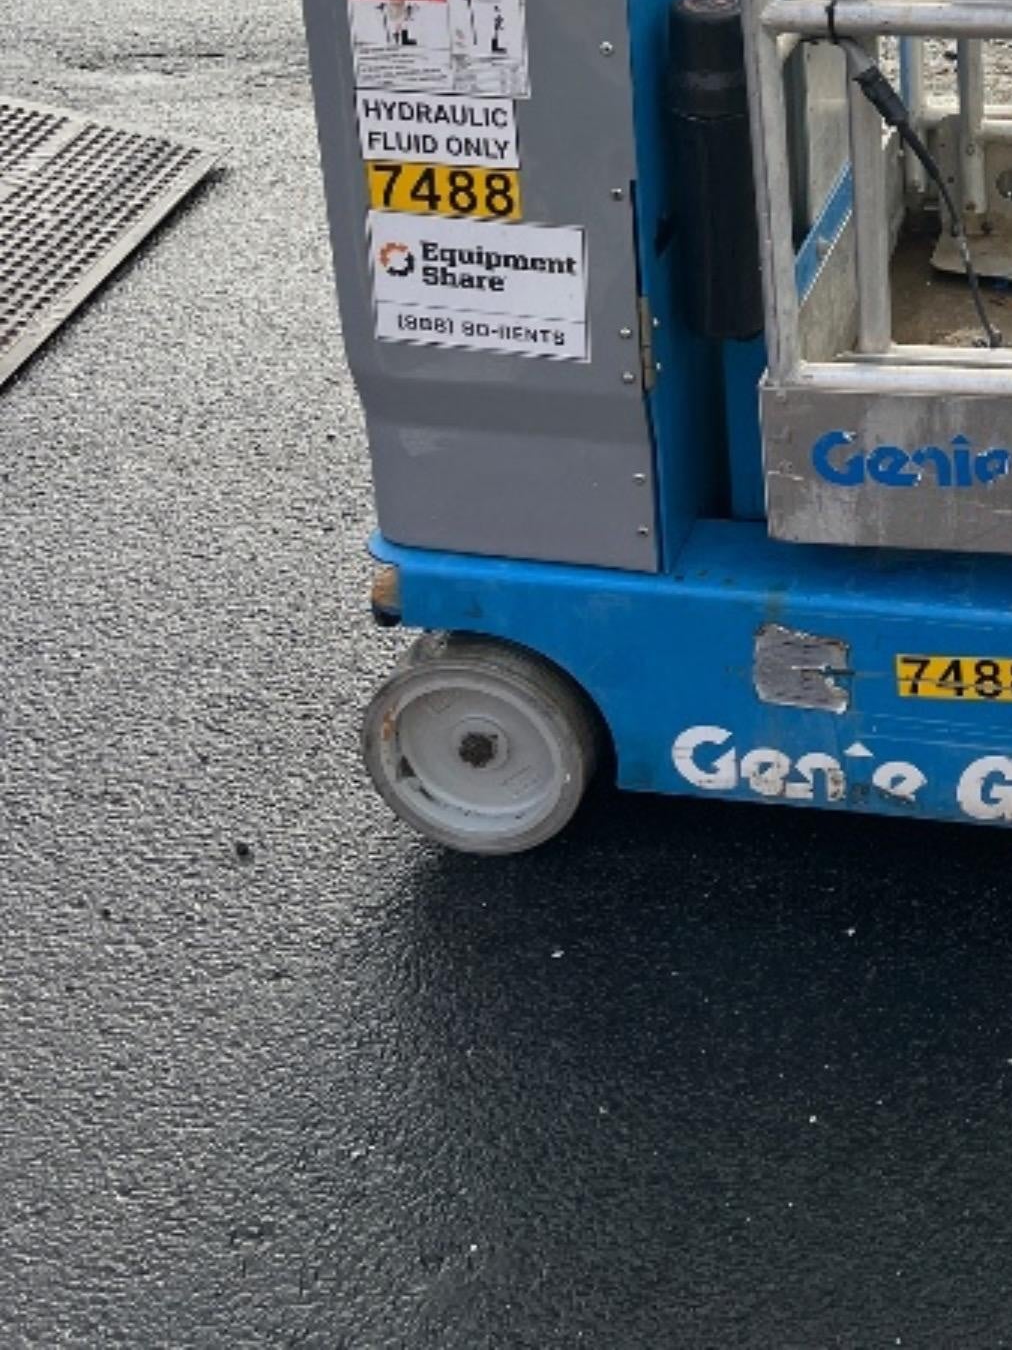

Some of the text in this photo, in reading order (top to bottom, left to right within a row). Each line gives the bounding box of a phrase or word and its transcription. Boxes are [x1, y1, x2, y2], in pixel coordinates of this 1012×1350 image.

[363, 99, 509, 128] HYDRAULIC
[367, 131, 510, 160] FLUID ONLY
[372, 164, 514, 217] 7488
[420, 240, 577, 276] Equipment
[422, 266, 506, 292] Share
[812, 430, 1012, 488] Genie
[671, 724, 928, 804] Gene
